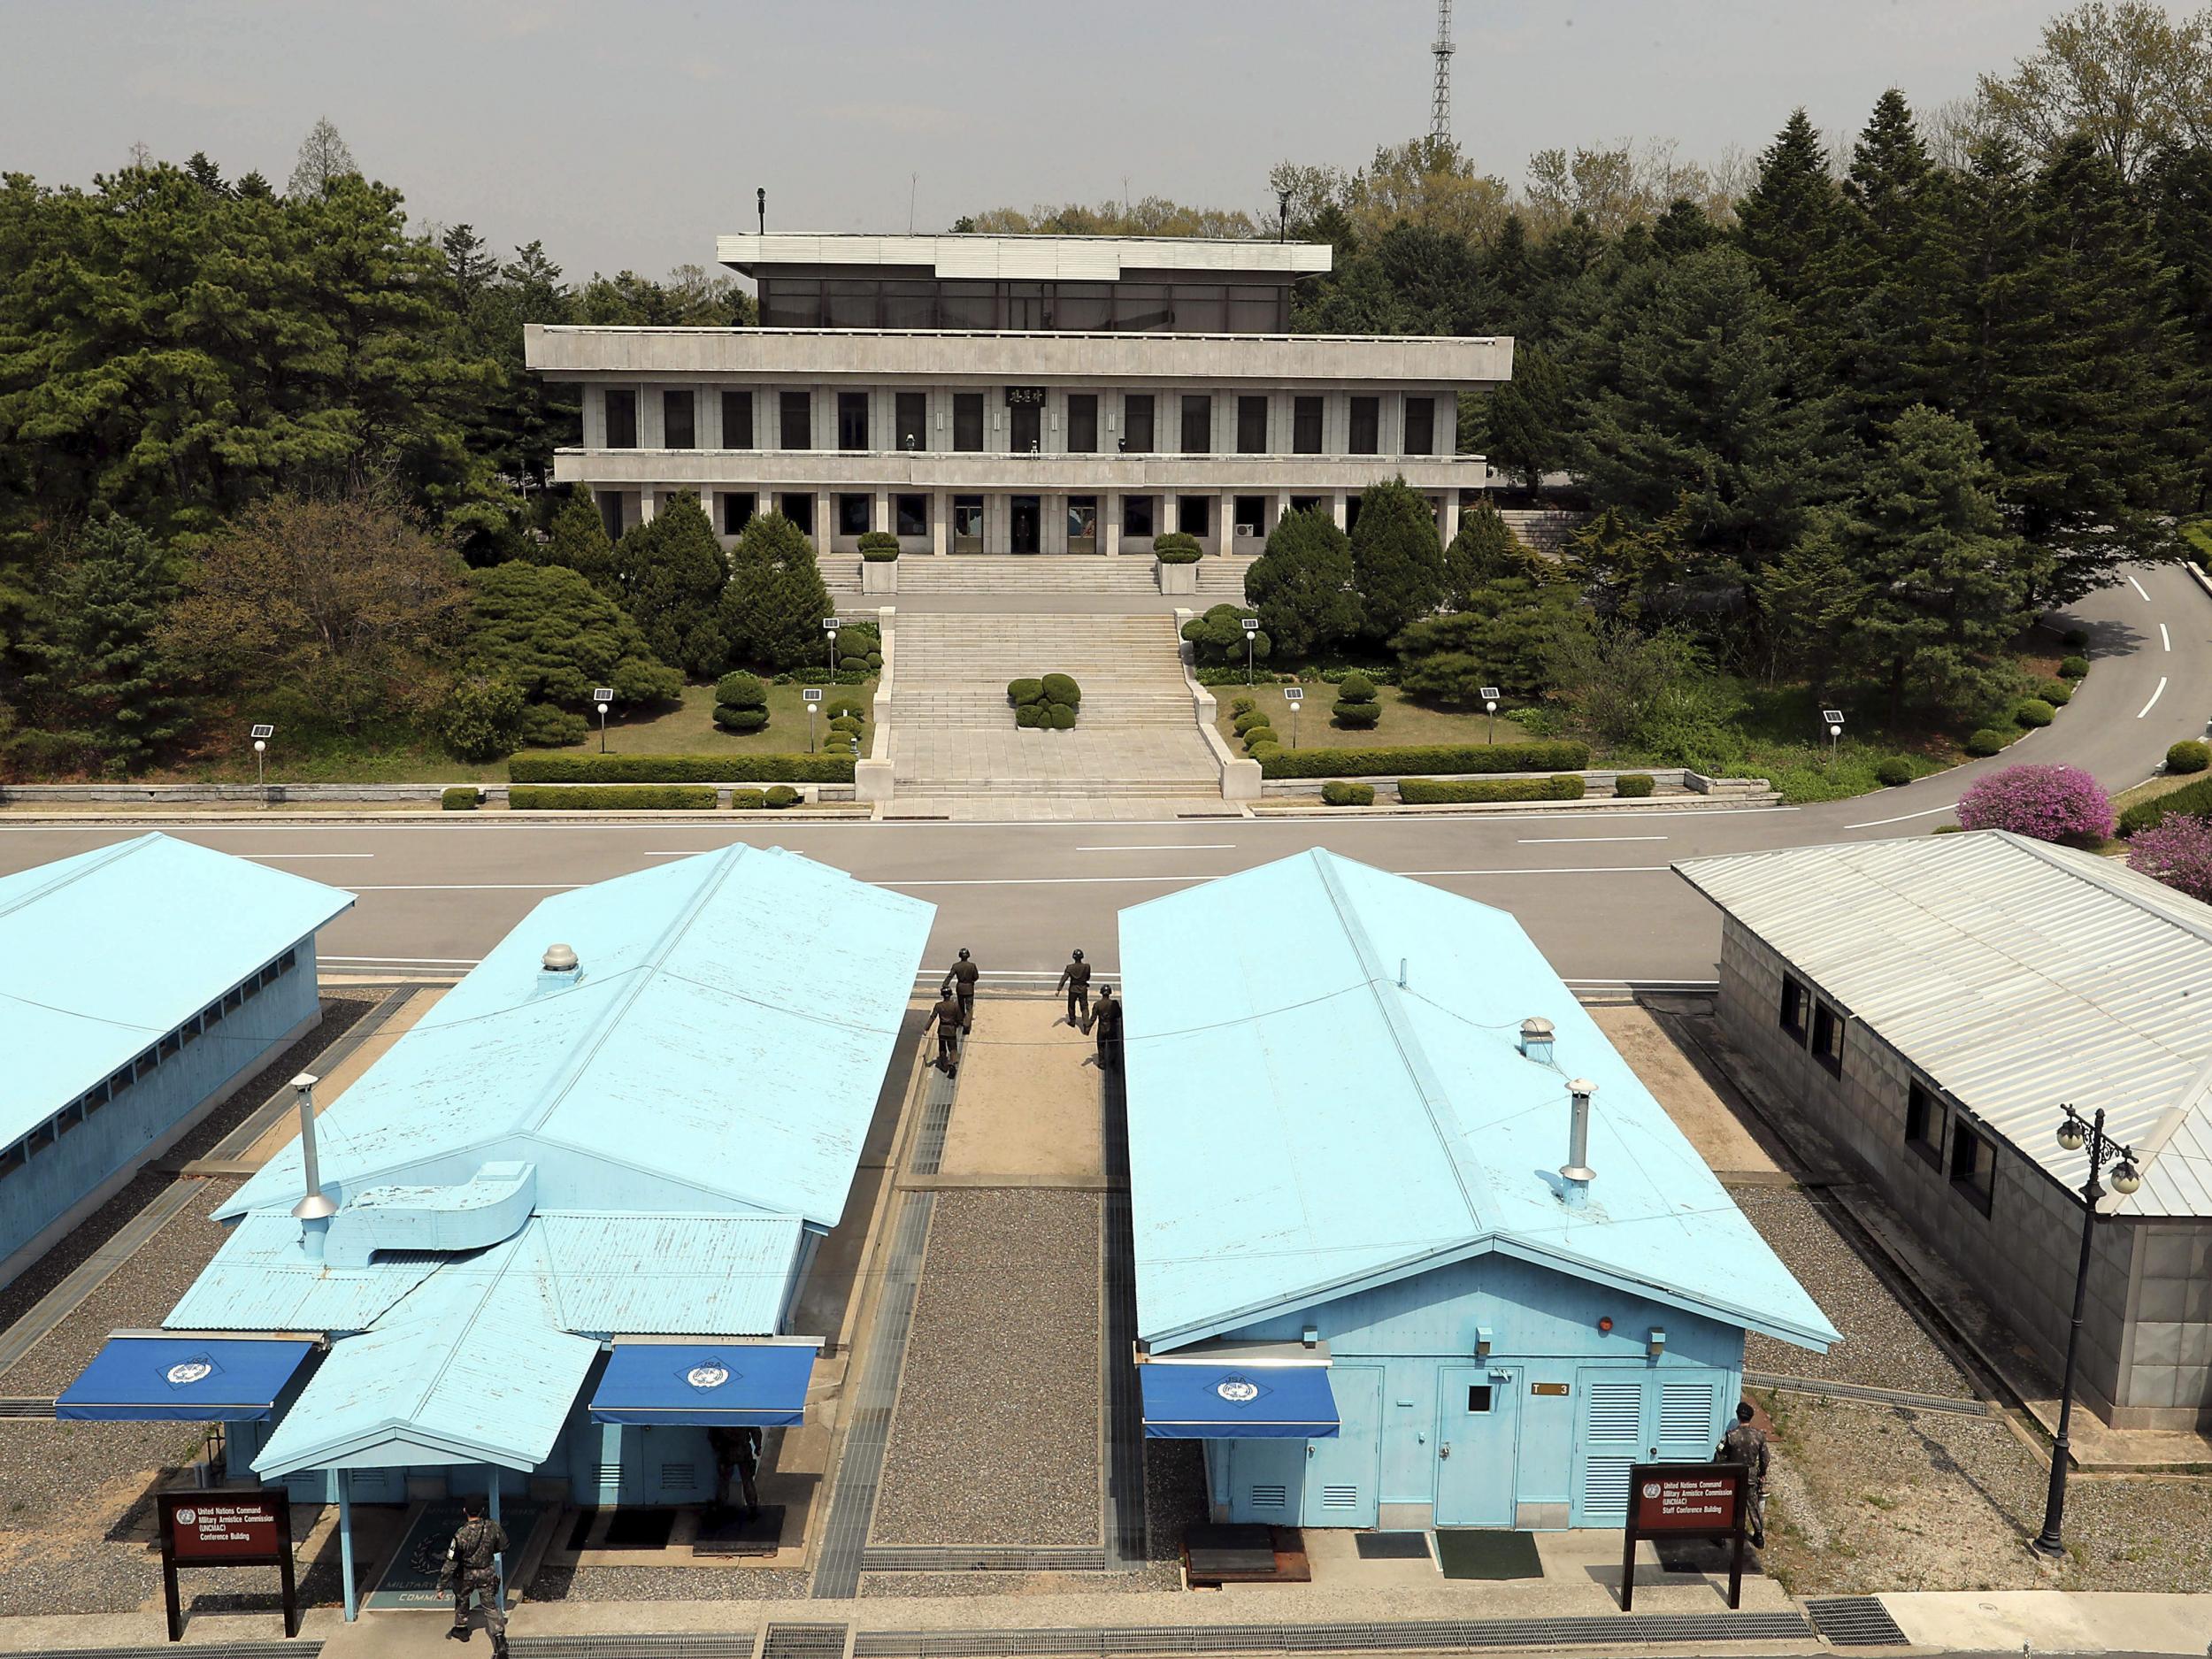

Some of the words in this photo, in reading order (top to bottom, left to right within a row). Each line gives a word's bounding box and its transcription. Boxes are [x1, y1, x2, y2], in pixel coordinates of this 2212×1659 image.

[1533, 1384, 1540, 1394] T
[1561, 1385, 1568, 1394] 3
[198, 1516, 217, 1525] Military
